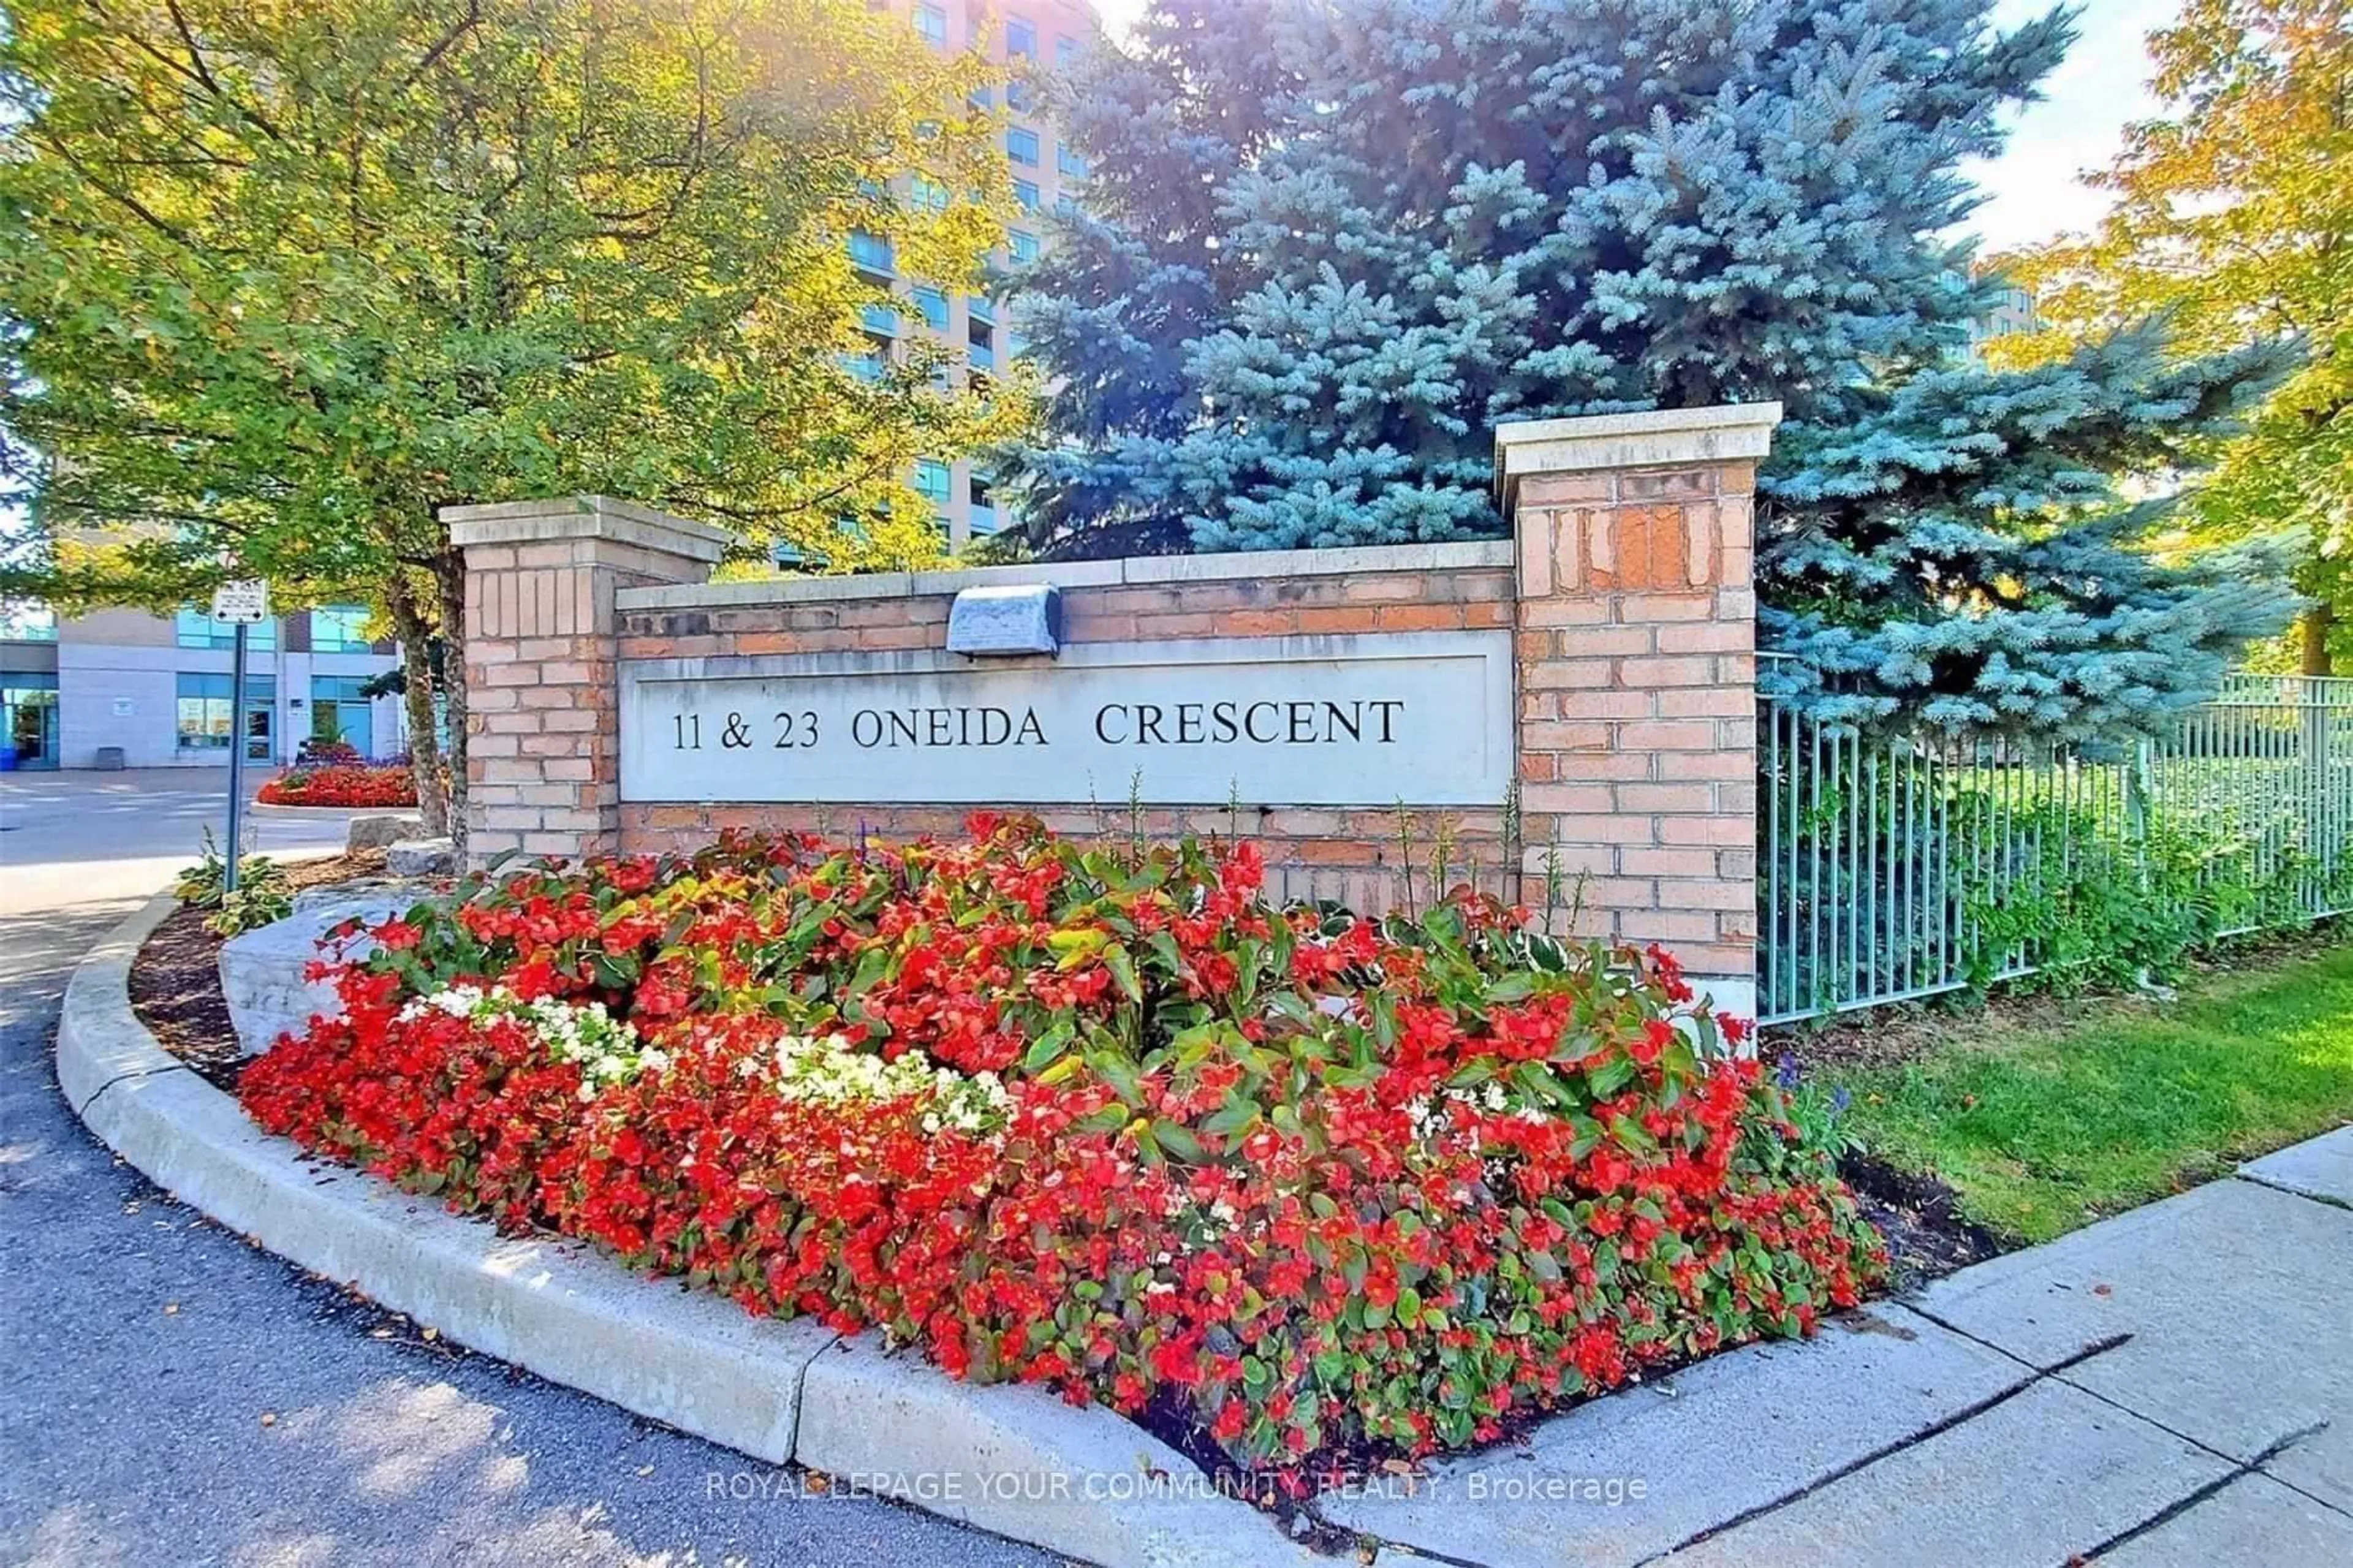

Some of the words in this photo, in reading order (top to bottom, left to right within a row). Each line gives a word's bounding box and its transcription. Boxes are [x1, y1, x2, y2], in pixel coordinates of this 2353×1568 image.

[673, 713, 702, 749] 11
[721, 712, 752, 748] &
[773, 711, 820, 748] 23
[852, 706, 1050, 748] ONEIDA
[1094, 700, 1405, 744] CRESCENT
